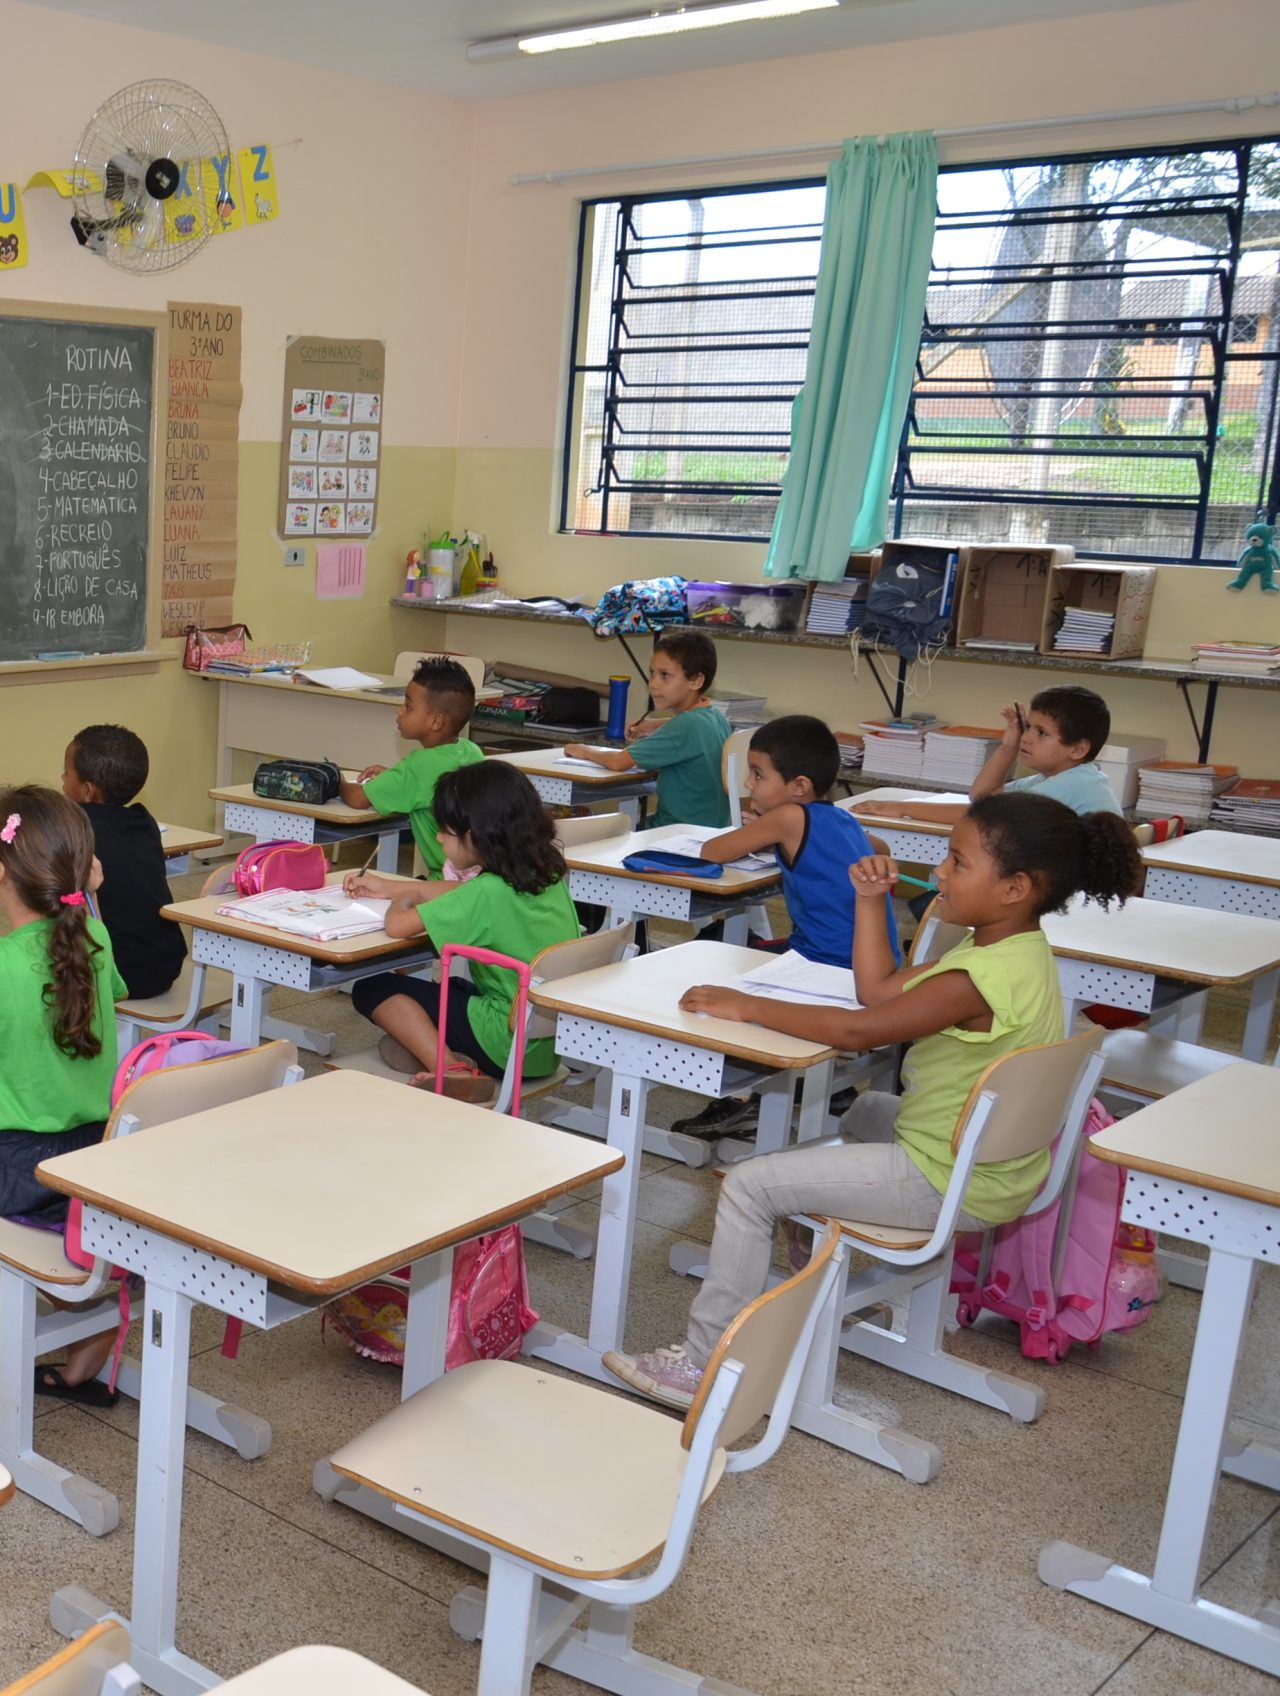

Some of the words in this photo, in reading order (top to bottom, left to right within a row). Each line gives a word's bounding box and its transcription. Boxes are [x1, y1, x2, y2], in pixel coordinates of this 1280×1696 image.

[251, 145, 270, 182] Z
[169, 309, 210, 332] TURMA
[216, 312, 233, 332] DO
[65, 345, 132, 371] ROTINA
[169, 359, 213, 381] BEATRIZ
[87, 381, 140, 410] FÍSICA
[171, 380, 209, 398] BIANCA
[167, 401, 199, 419] BRUNA
[167, 421, 199, 440] BRUNO
[165, 463, 199, 481] FELIPE
[164, 525, 200, 542] LUANA
[163, 563, 212, 580] MATHEUS
[85, 576, 100, 598] DE
[105, 579, 138, 600] CASA
[61, 604, 104, 627] EMBORA
